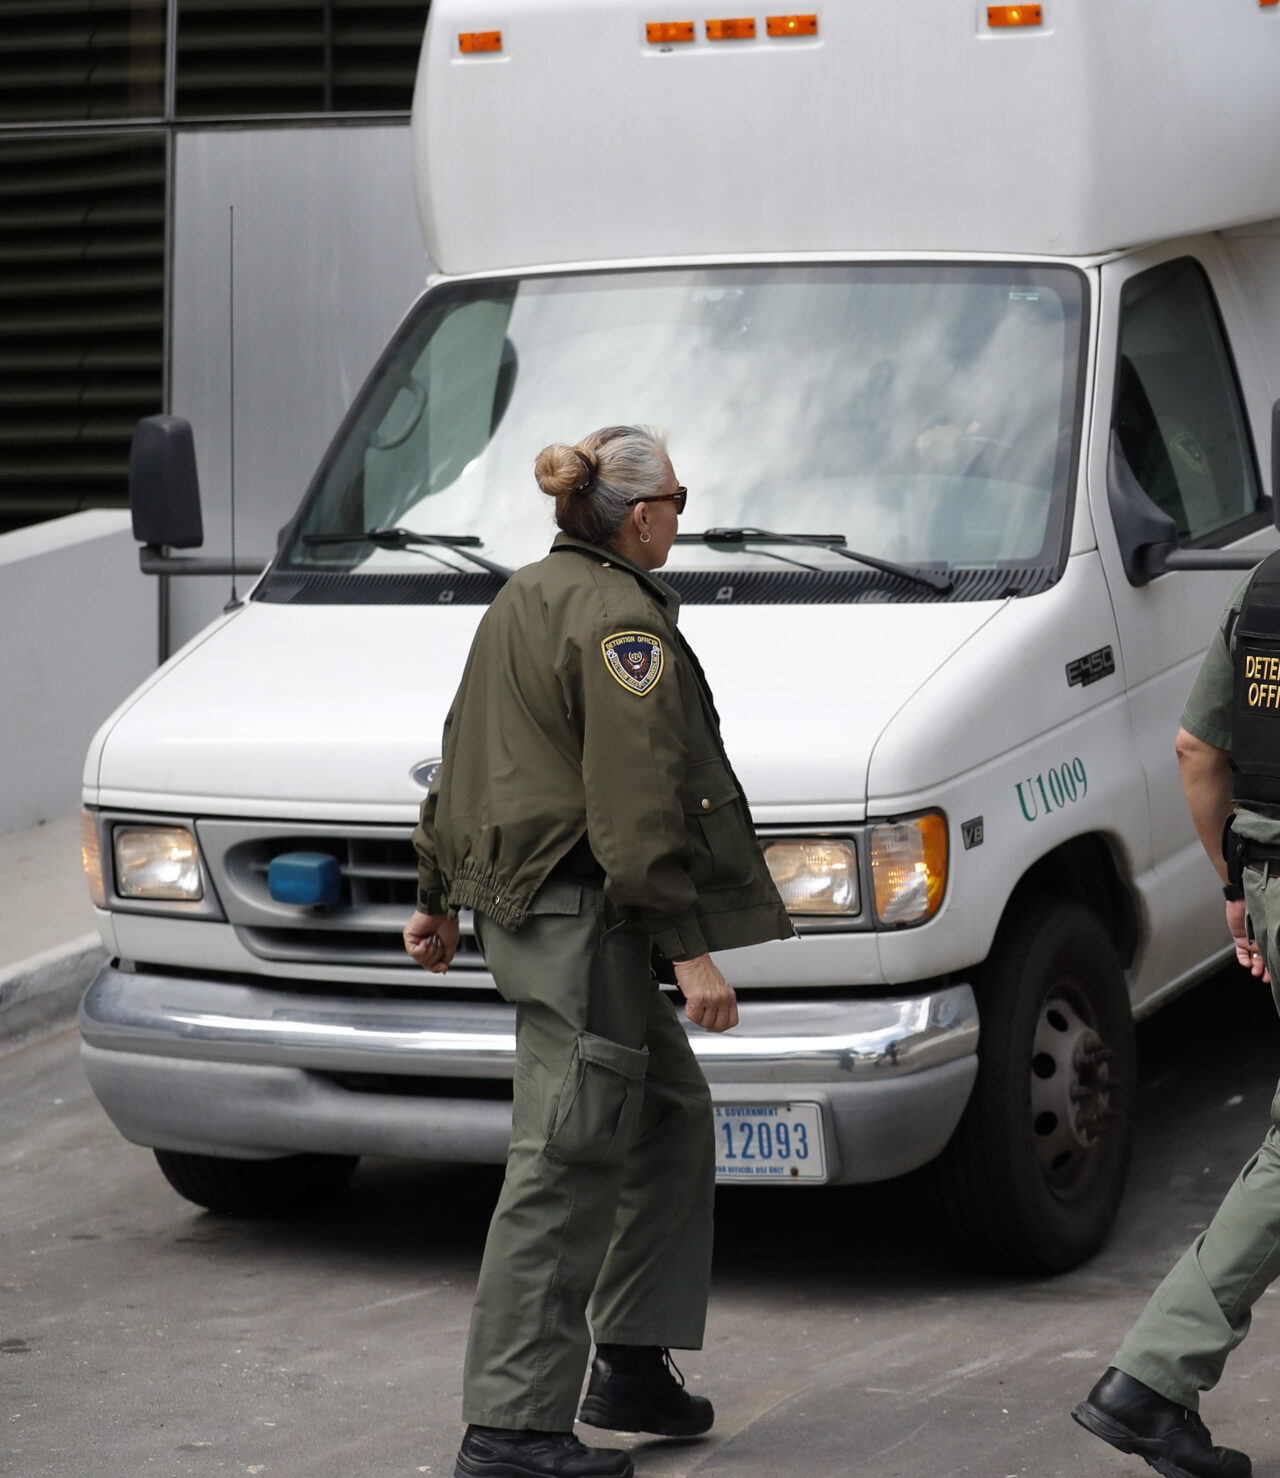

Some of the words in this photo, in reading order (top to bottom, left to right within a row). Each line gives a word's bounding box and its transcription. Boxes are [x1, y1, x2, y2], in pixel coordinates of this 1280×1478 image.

[605, 636, 636, 649] DETENTION
[637, 636, 658, 646] OFFICER
[1014, 757, 1089, 822] U1009
[963, 825, 983, 849] V8
[725, 1107, 778, 1118] GOVERNMENT
[721, 1122, 809, 1160] 12093
[728, 1166, 754, 1174] OFFICIAL
[756, 1166, 767, 1174] USE
[769, 1167, 784, 1175] ONLY
